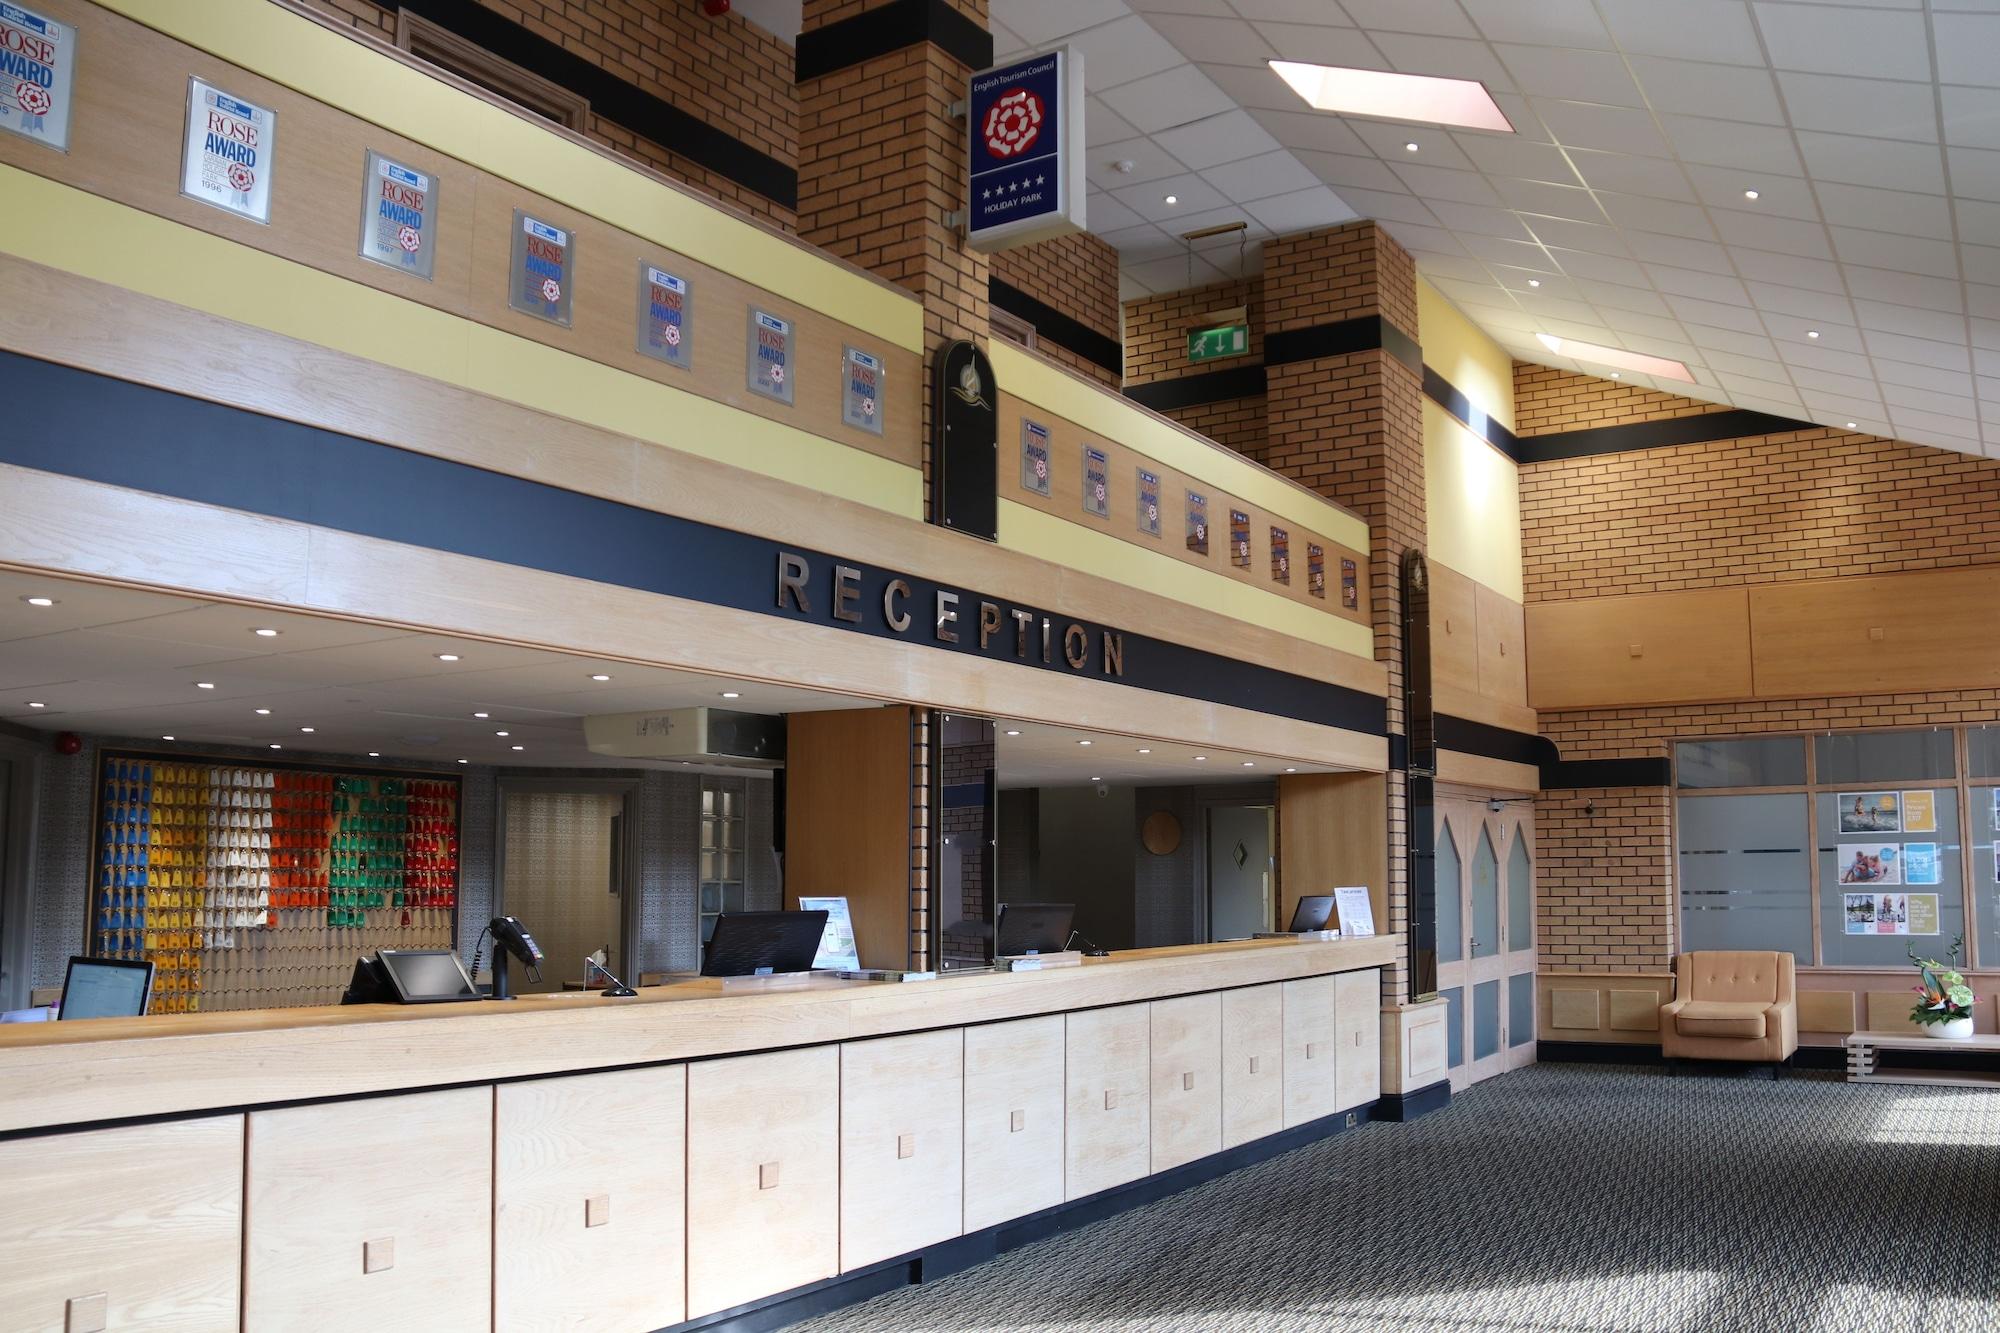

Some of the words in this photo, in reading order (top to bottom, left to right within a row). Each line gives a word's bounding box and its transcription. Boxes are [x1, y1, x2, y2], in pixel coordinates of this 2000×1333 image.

[0, 48, 53, 88] WARD
[974, 79, 999, 93] English
[999, 70, 1027, 85] Tourism
[1027, 60, 1055, 76] Council
[208, 111, 258, 147] ROSE
[205, 132, 256, 168] AWARD
[201, 182, 222, 193] 1996
[382, 181, 424, 211] ROSE
[379, 199, 422, 230] AWARD
[984, 198, 1019, 214] HOLIDAY
[1021, 192, 1043, 205] PARK
[528, 236, 562, 264] ROSE
[651, 285, 682, 311] ROSE
[650, 302, 682, 327] AWARD
[758, 327, 785, 351] ROSE
[758, 344, 785, 366] AWARD
[852, 364, 876, 385] ROSE
[851, 378, 876, 400] AWARD
[1026, 443, 1047, 462] AWARD
[777, 552, 1123, 676] RECEPTION
